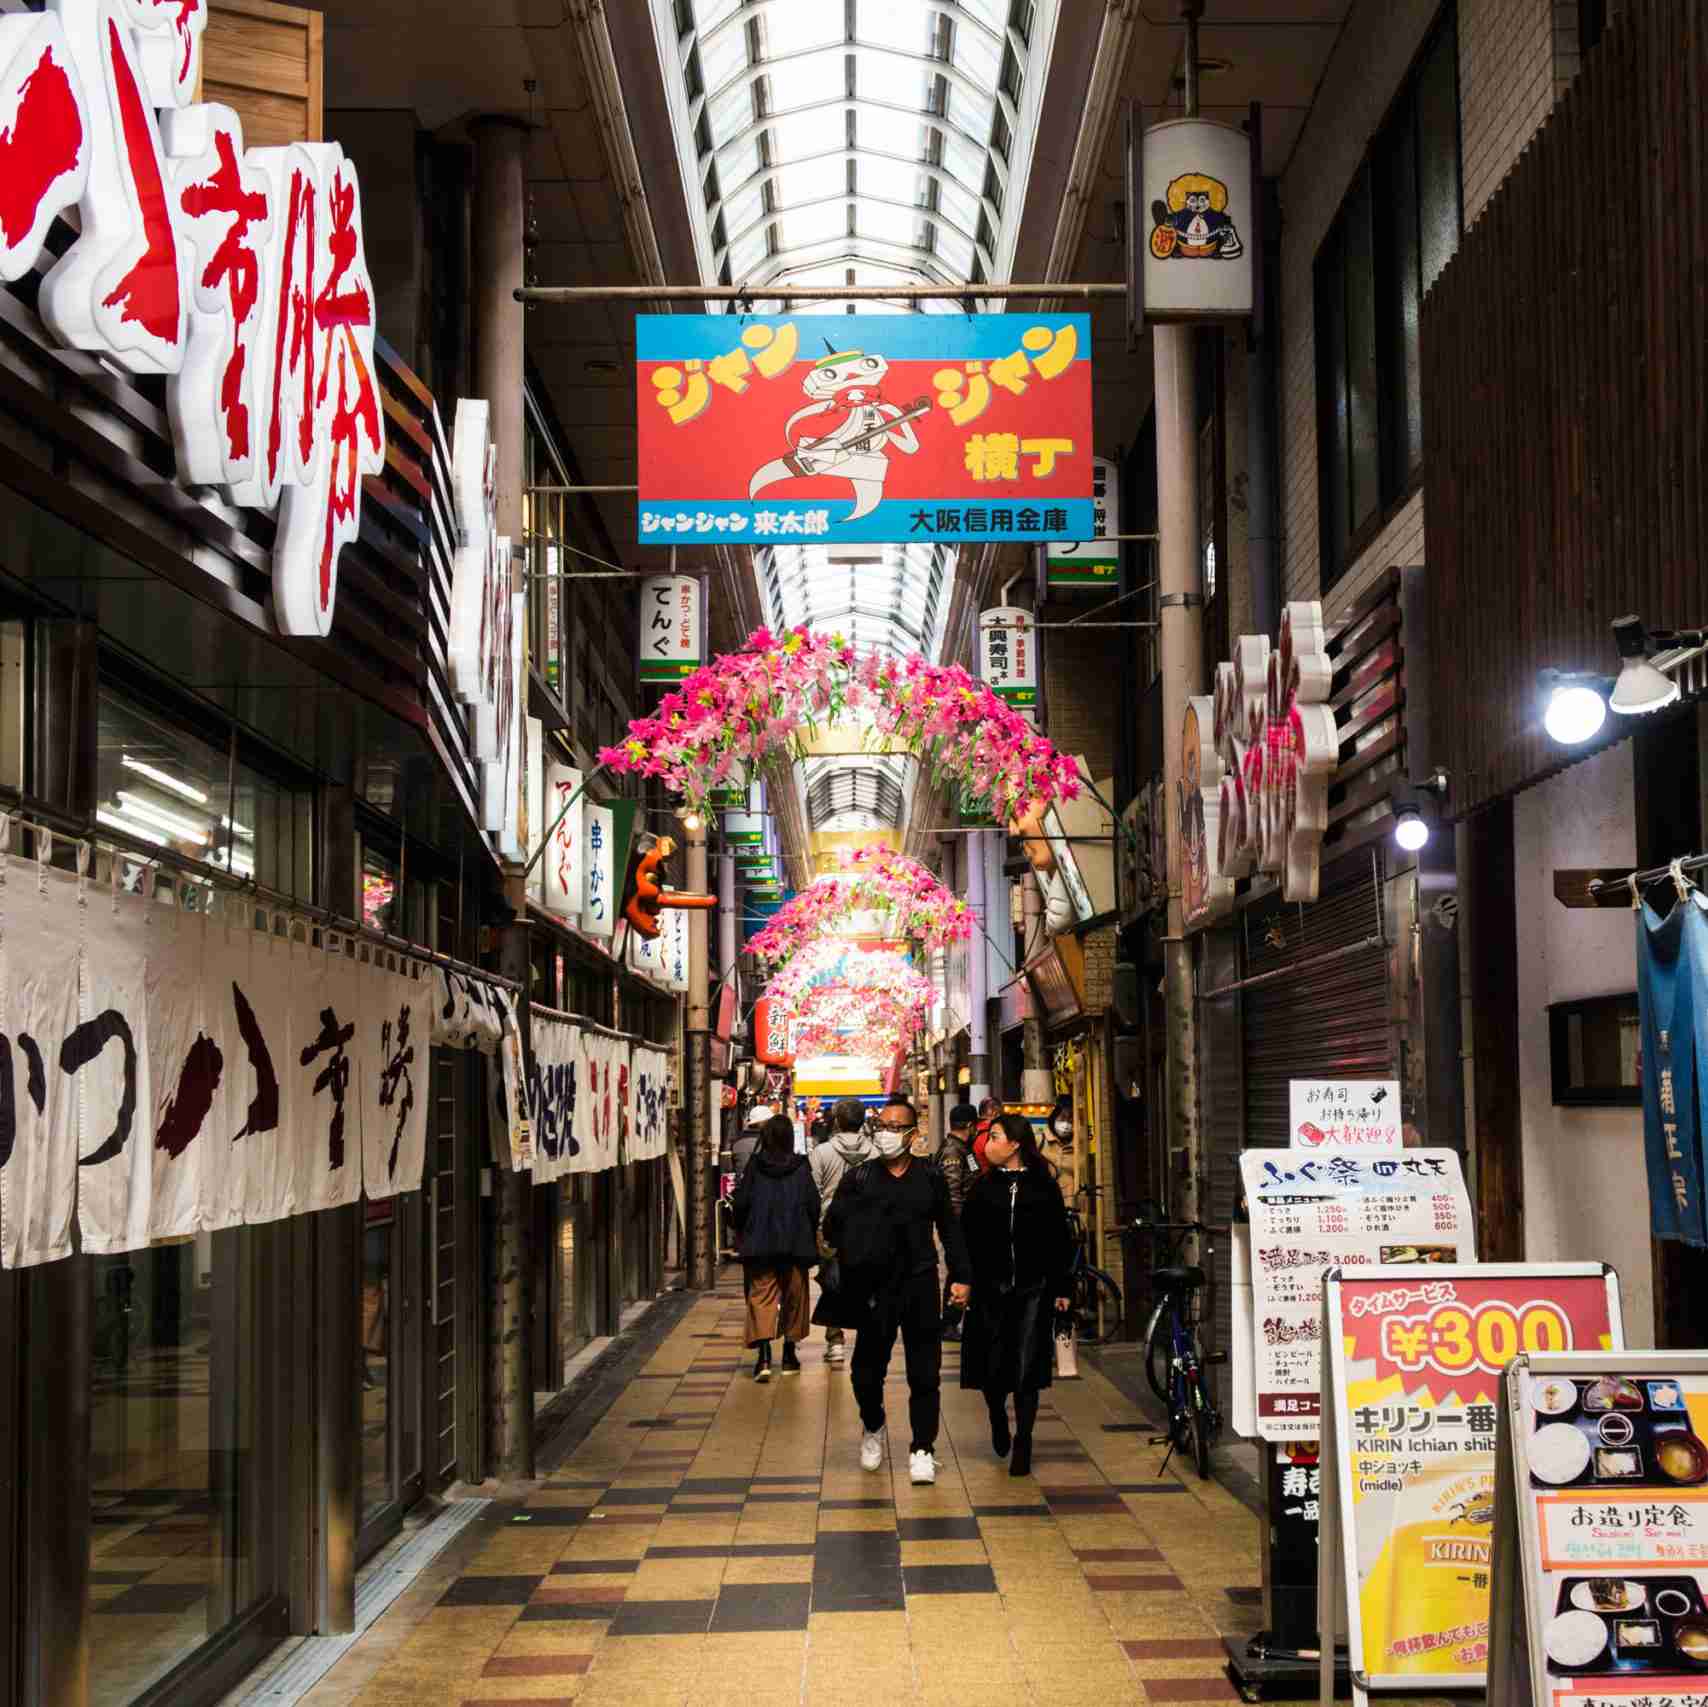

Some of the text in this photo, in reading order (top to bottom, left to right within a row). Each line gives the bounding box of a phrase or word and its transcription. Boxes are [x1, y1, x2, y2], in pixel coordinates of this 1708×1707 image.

[652, 321, 1078, 426] ジャン ジャン
[964, 432, 1074, 482] 横丁
[641, 511, 749, 534] ジャンジャン
[910, 508, 1069, 534] 大阪信用金庫
[652, 587, 672, 656] てんぐ
[591, 819, 604, 921] 串かつ
[1350, 1281, 1458, 1319] タイムサービス
[1387, 1307, 1568, 1367] ¥300
[1354, 1404, 1496, 1433] キリン一番
[1357, 1439, 1402, 1452] KIRIN
[1409, 1439, 1458, 1452] Ichian
[1359, 1478, 1404, 1492] (midle)
[1571, 1505, 1695, 1527] お造り定食
[1431, 1543, 1490, 1562] KIRIN
